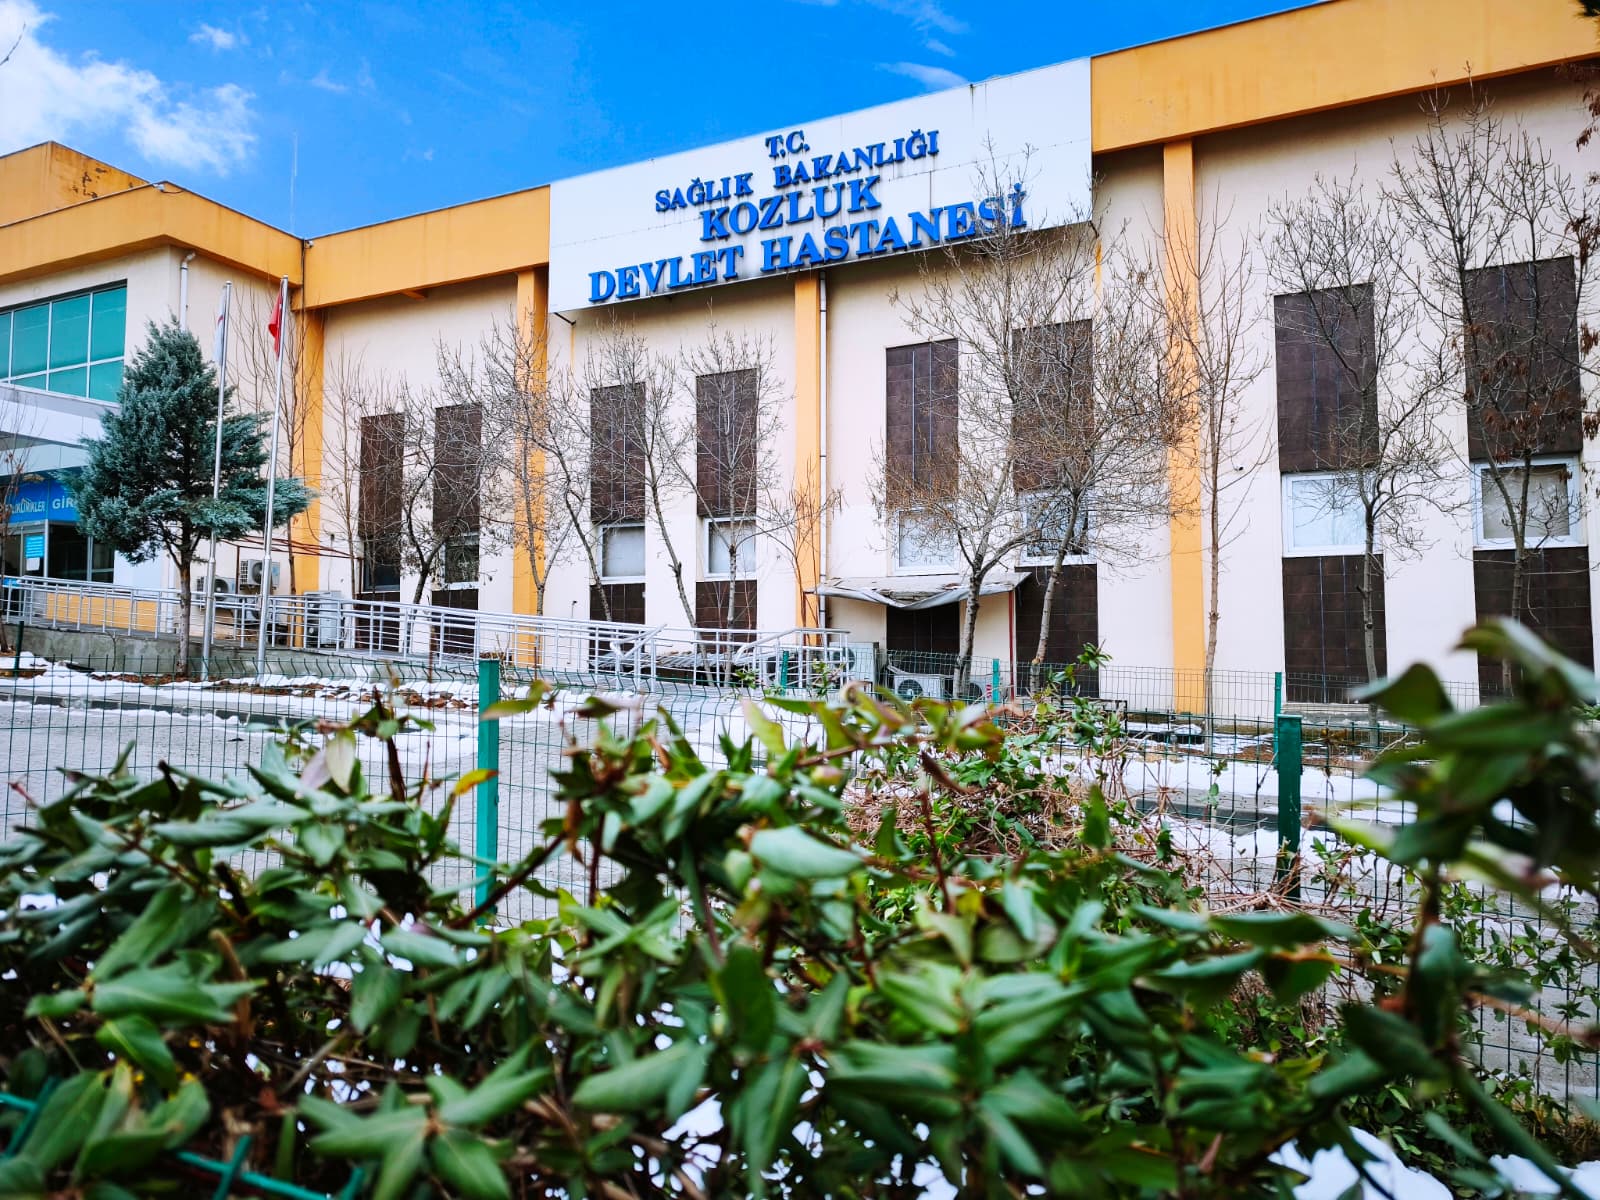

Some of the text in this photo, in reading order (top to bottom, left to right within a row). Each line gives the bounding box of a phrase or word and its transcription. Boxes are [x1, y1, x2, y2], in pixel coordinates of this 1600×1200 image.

[655, 129, 940, 212] SAĞLIK BAKANLIĞI
[765, 130, 809, 158] T.C.
[588, 183, 1027, 303] DEVLET HASTANESİ
[700, 175, 881, 241] KOZLUK
